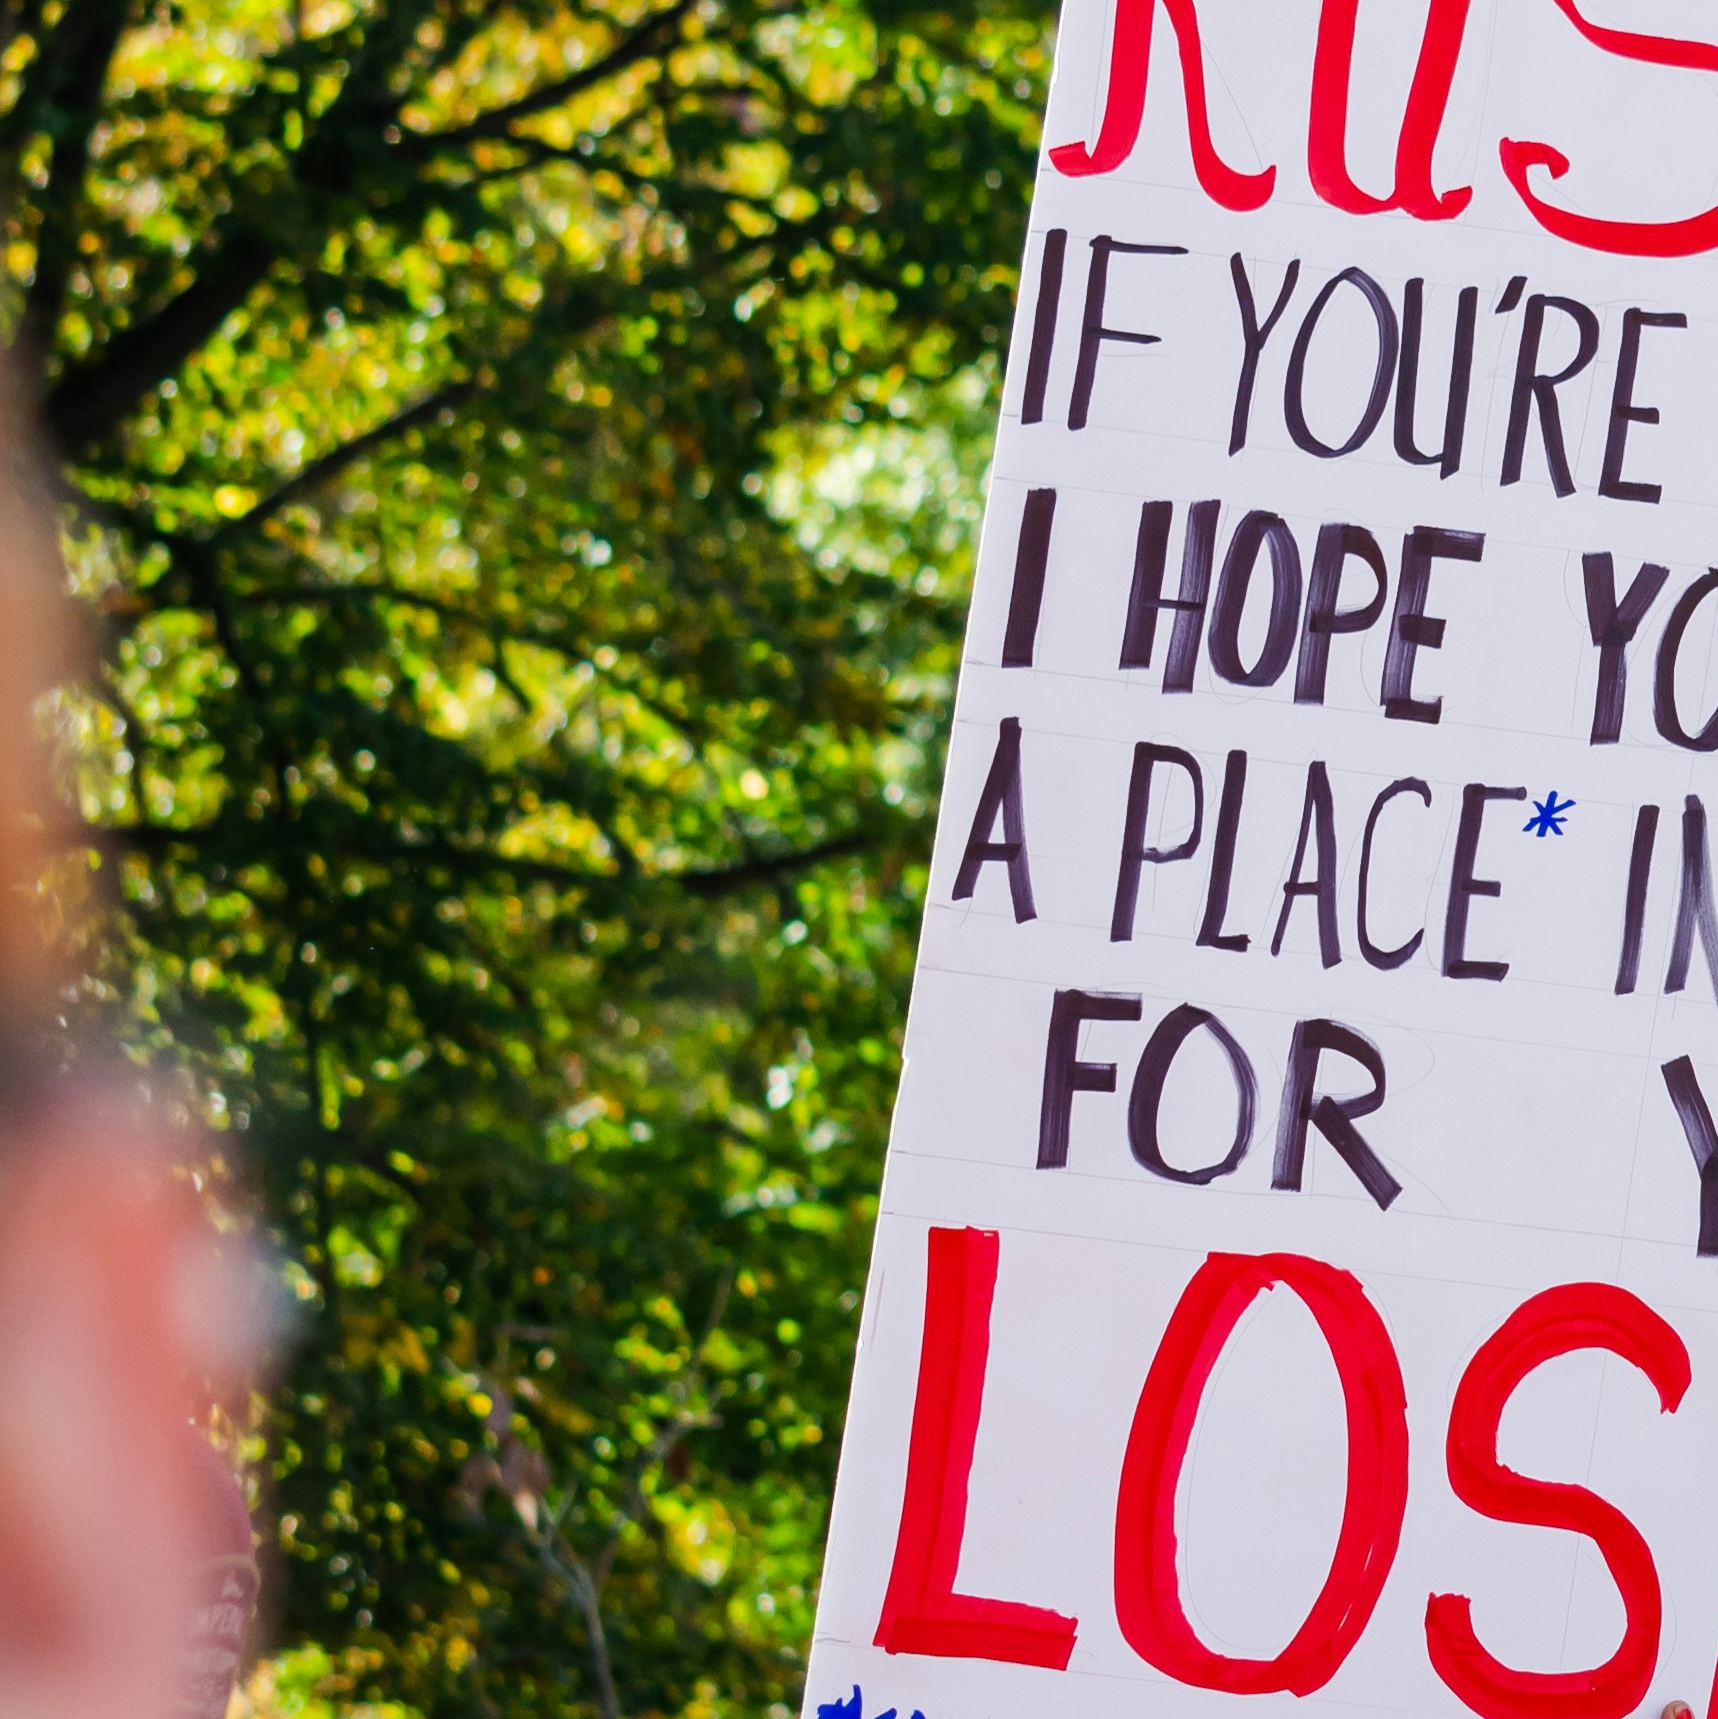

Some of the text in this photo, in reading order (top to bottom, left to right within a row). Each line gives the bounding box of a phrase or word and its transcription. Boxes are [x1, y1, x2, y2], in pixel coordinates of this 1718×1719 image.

[1021, 229, 1189, 431] IF
[1229, 252, 1687, 504] YOU'RE
[1002, 488, 1056, 668] I
[1119, 499, 1485, 724] HOPE
[952, 717, 1037, 924] A
[1036, 989, 1402, 1211] FOR
